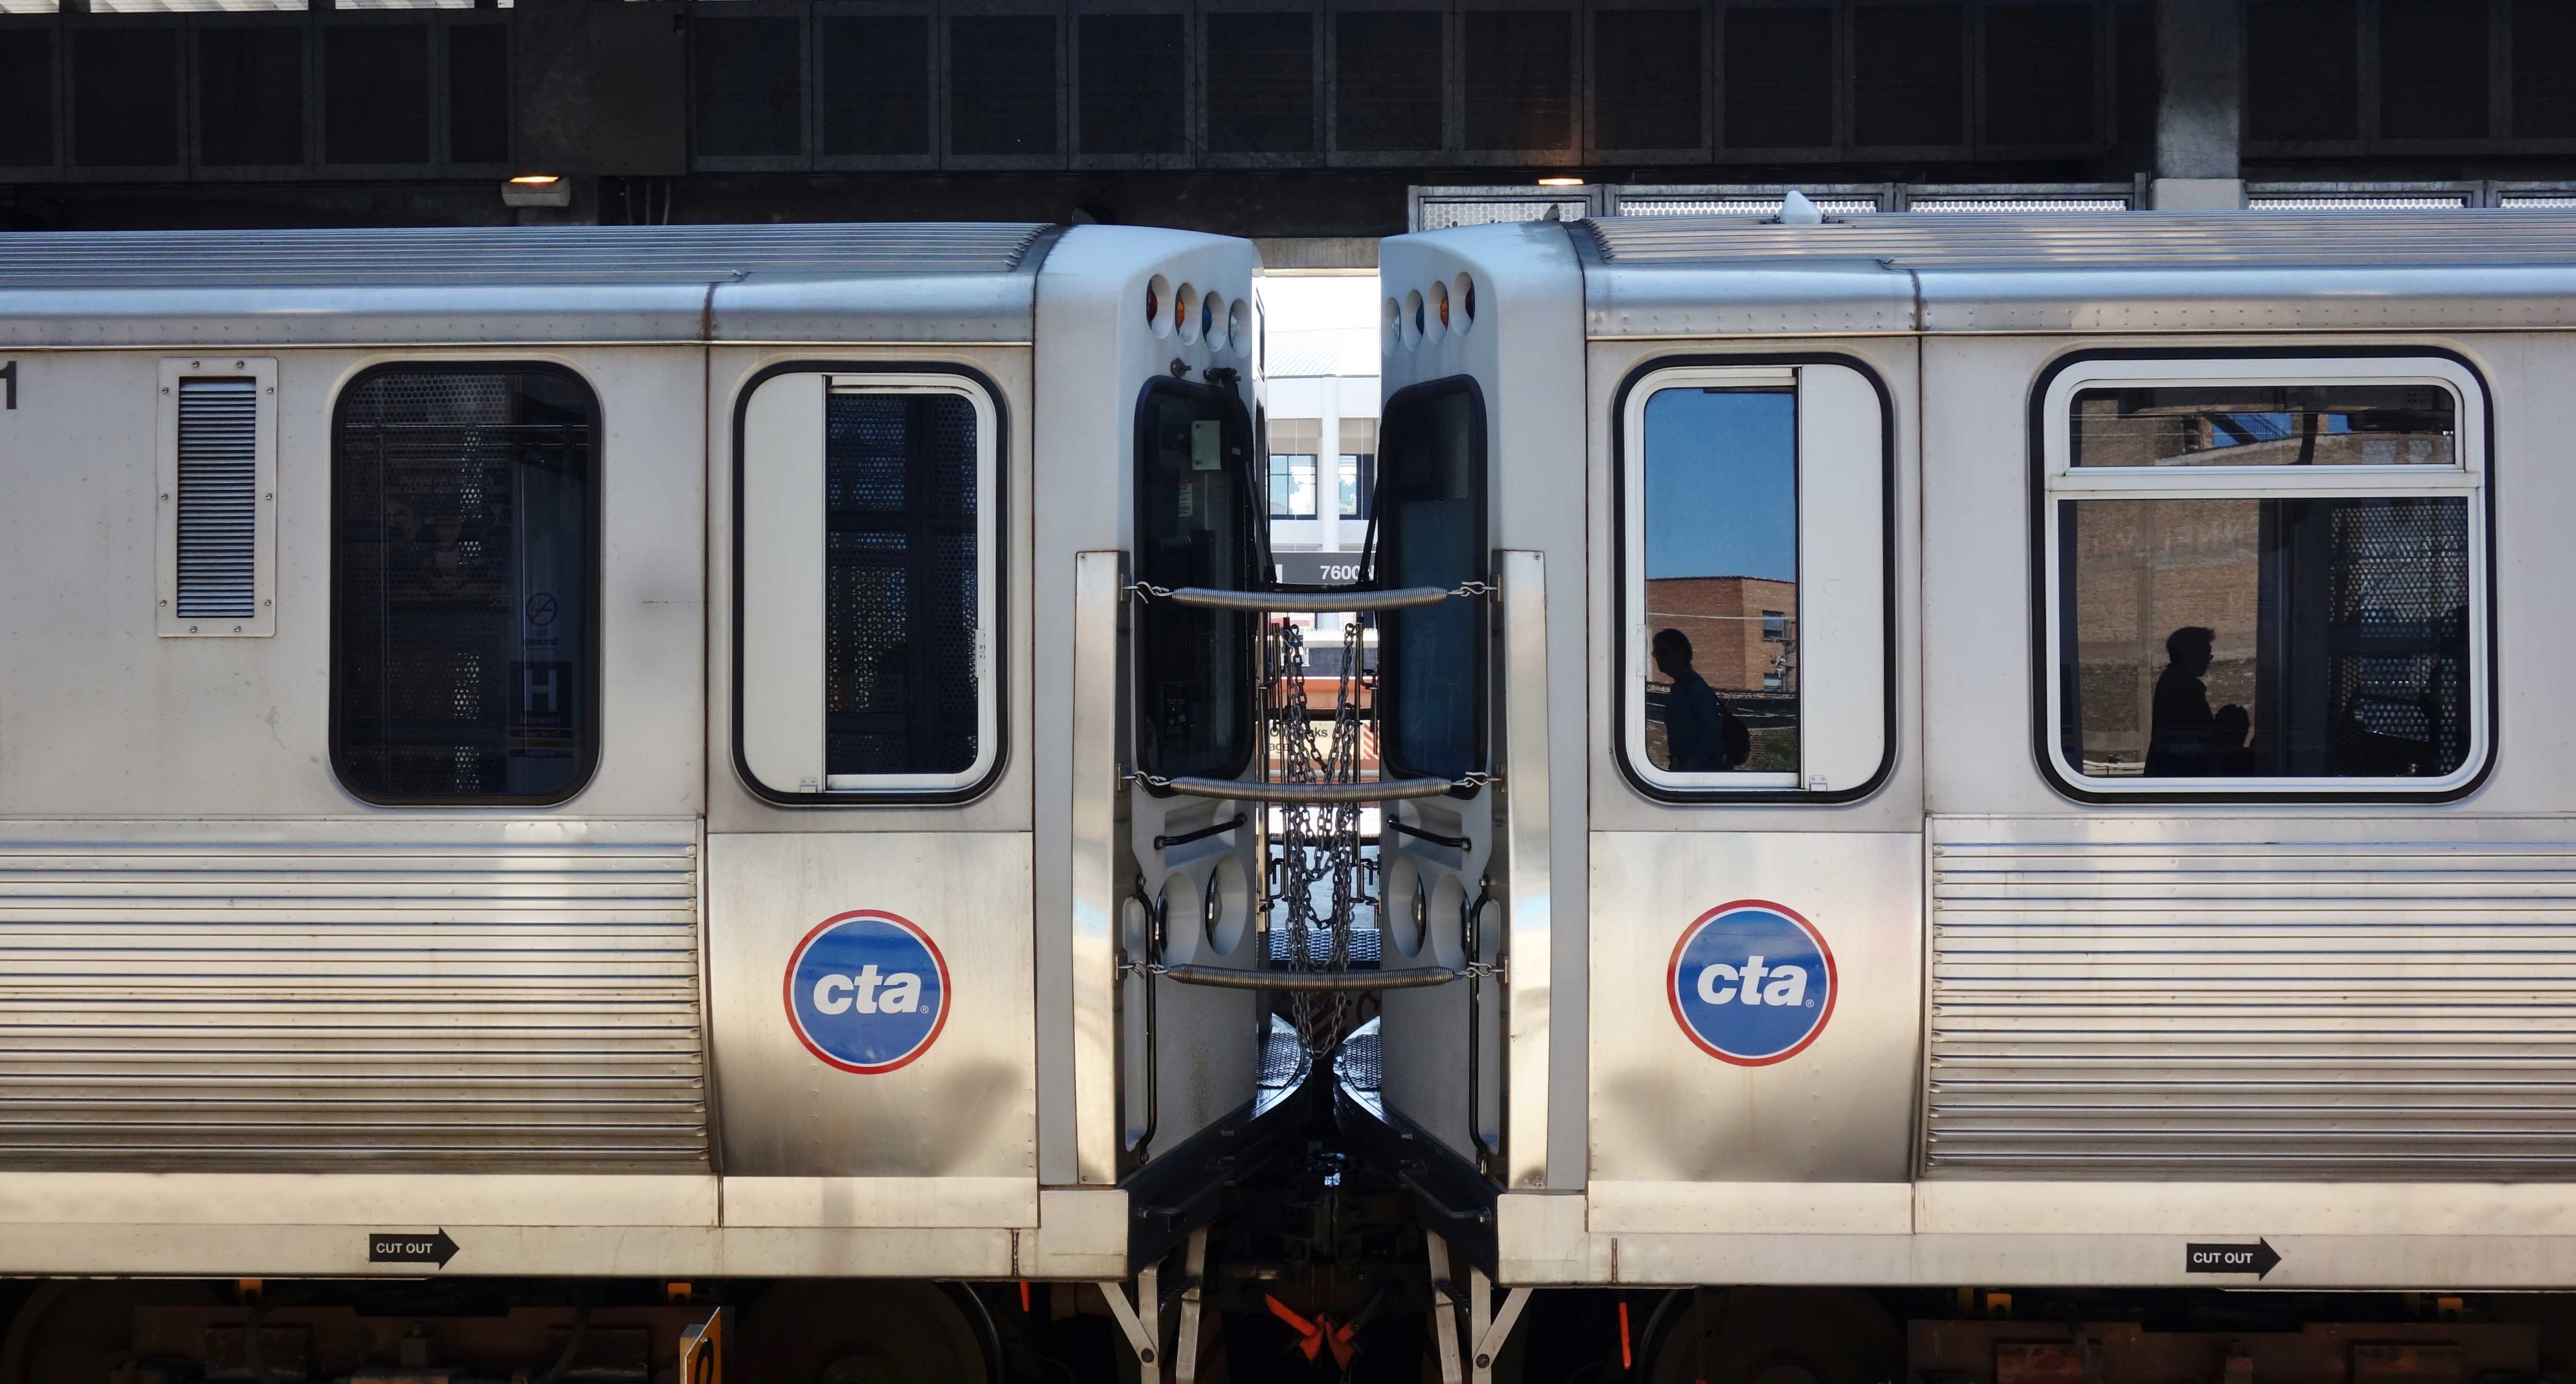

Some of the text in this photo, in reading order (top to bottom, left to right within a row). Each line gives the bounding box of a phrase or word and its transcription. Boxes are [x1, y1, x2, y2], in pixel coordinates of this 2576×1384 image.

[376, 1243, 433, 1253] CUT OUT
[2193, 1252, 2253, 1263] CUT OUT
